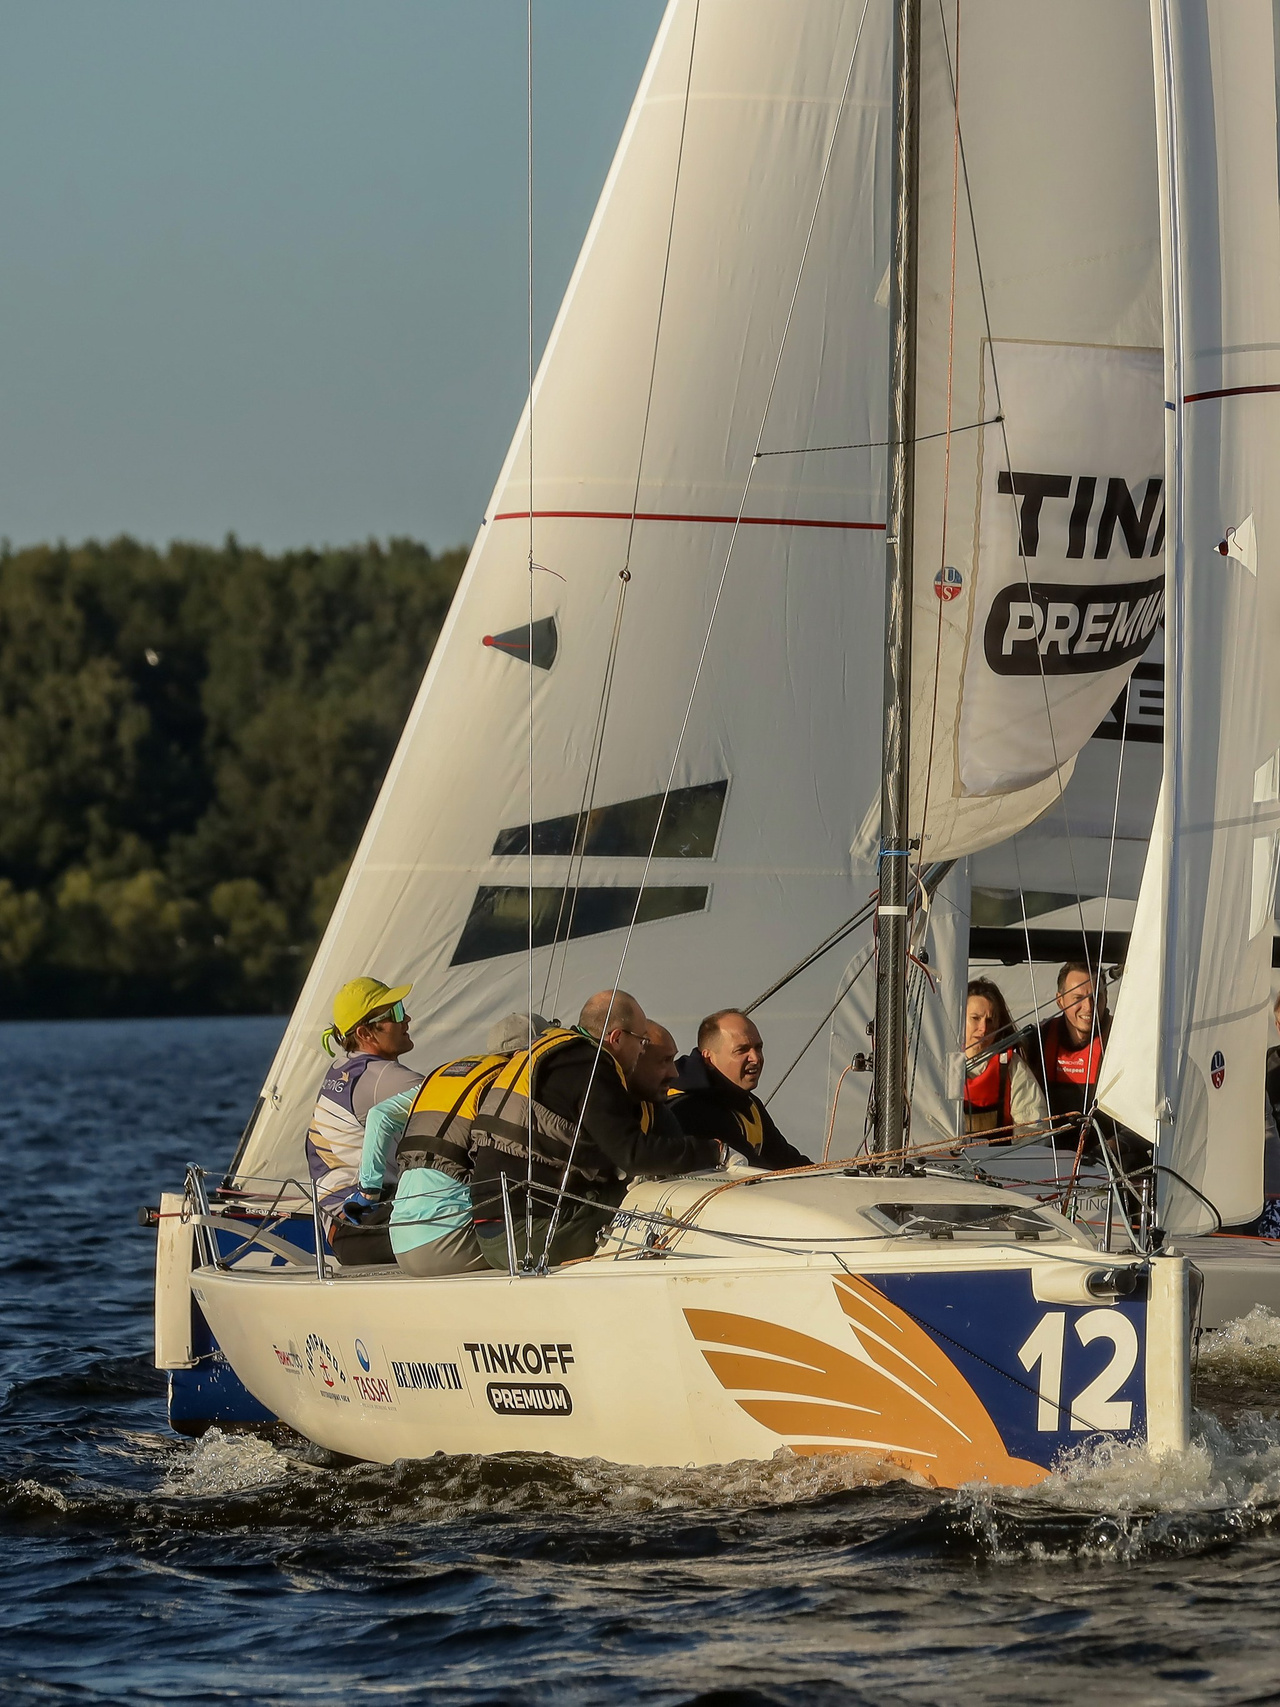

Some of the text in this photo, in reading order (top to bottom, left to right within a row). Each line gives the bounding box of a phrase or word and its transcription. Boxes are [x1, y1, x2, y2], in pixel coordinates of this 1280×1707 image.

[998, 471, 1165, 559] TIN
[463, 1343, 575, 1374] TINKOFF
[1017, 1307, 1139, 1432] 12
[353, 1376, 393, 1403] TASSAY
[391, 1361, 464, 1392] ВЕДОМОСТИ
[490, 1388, 568, 1410] PREMIUM
